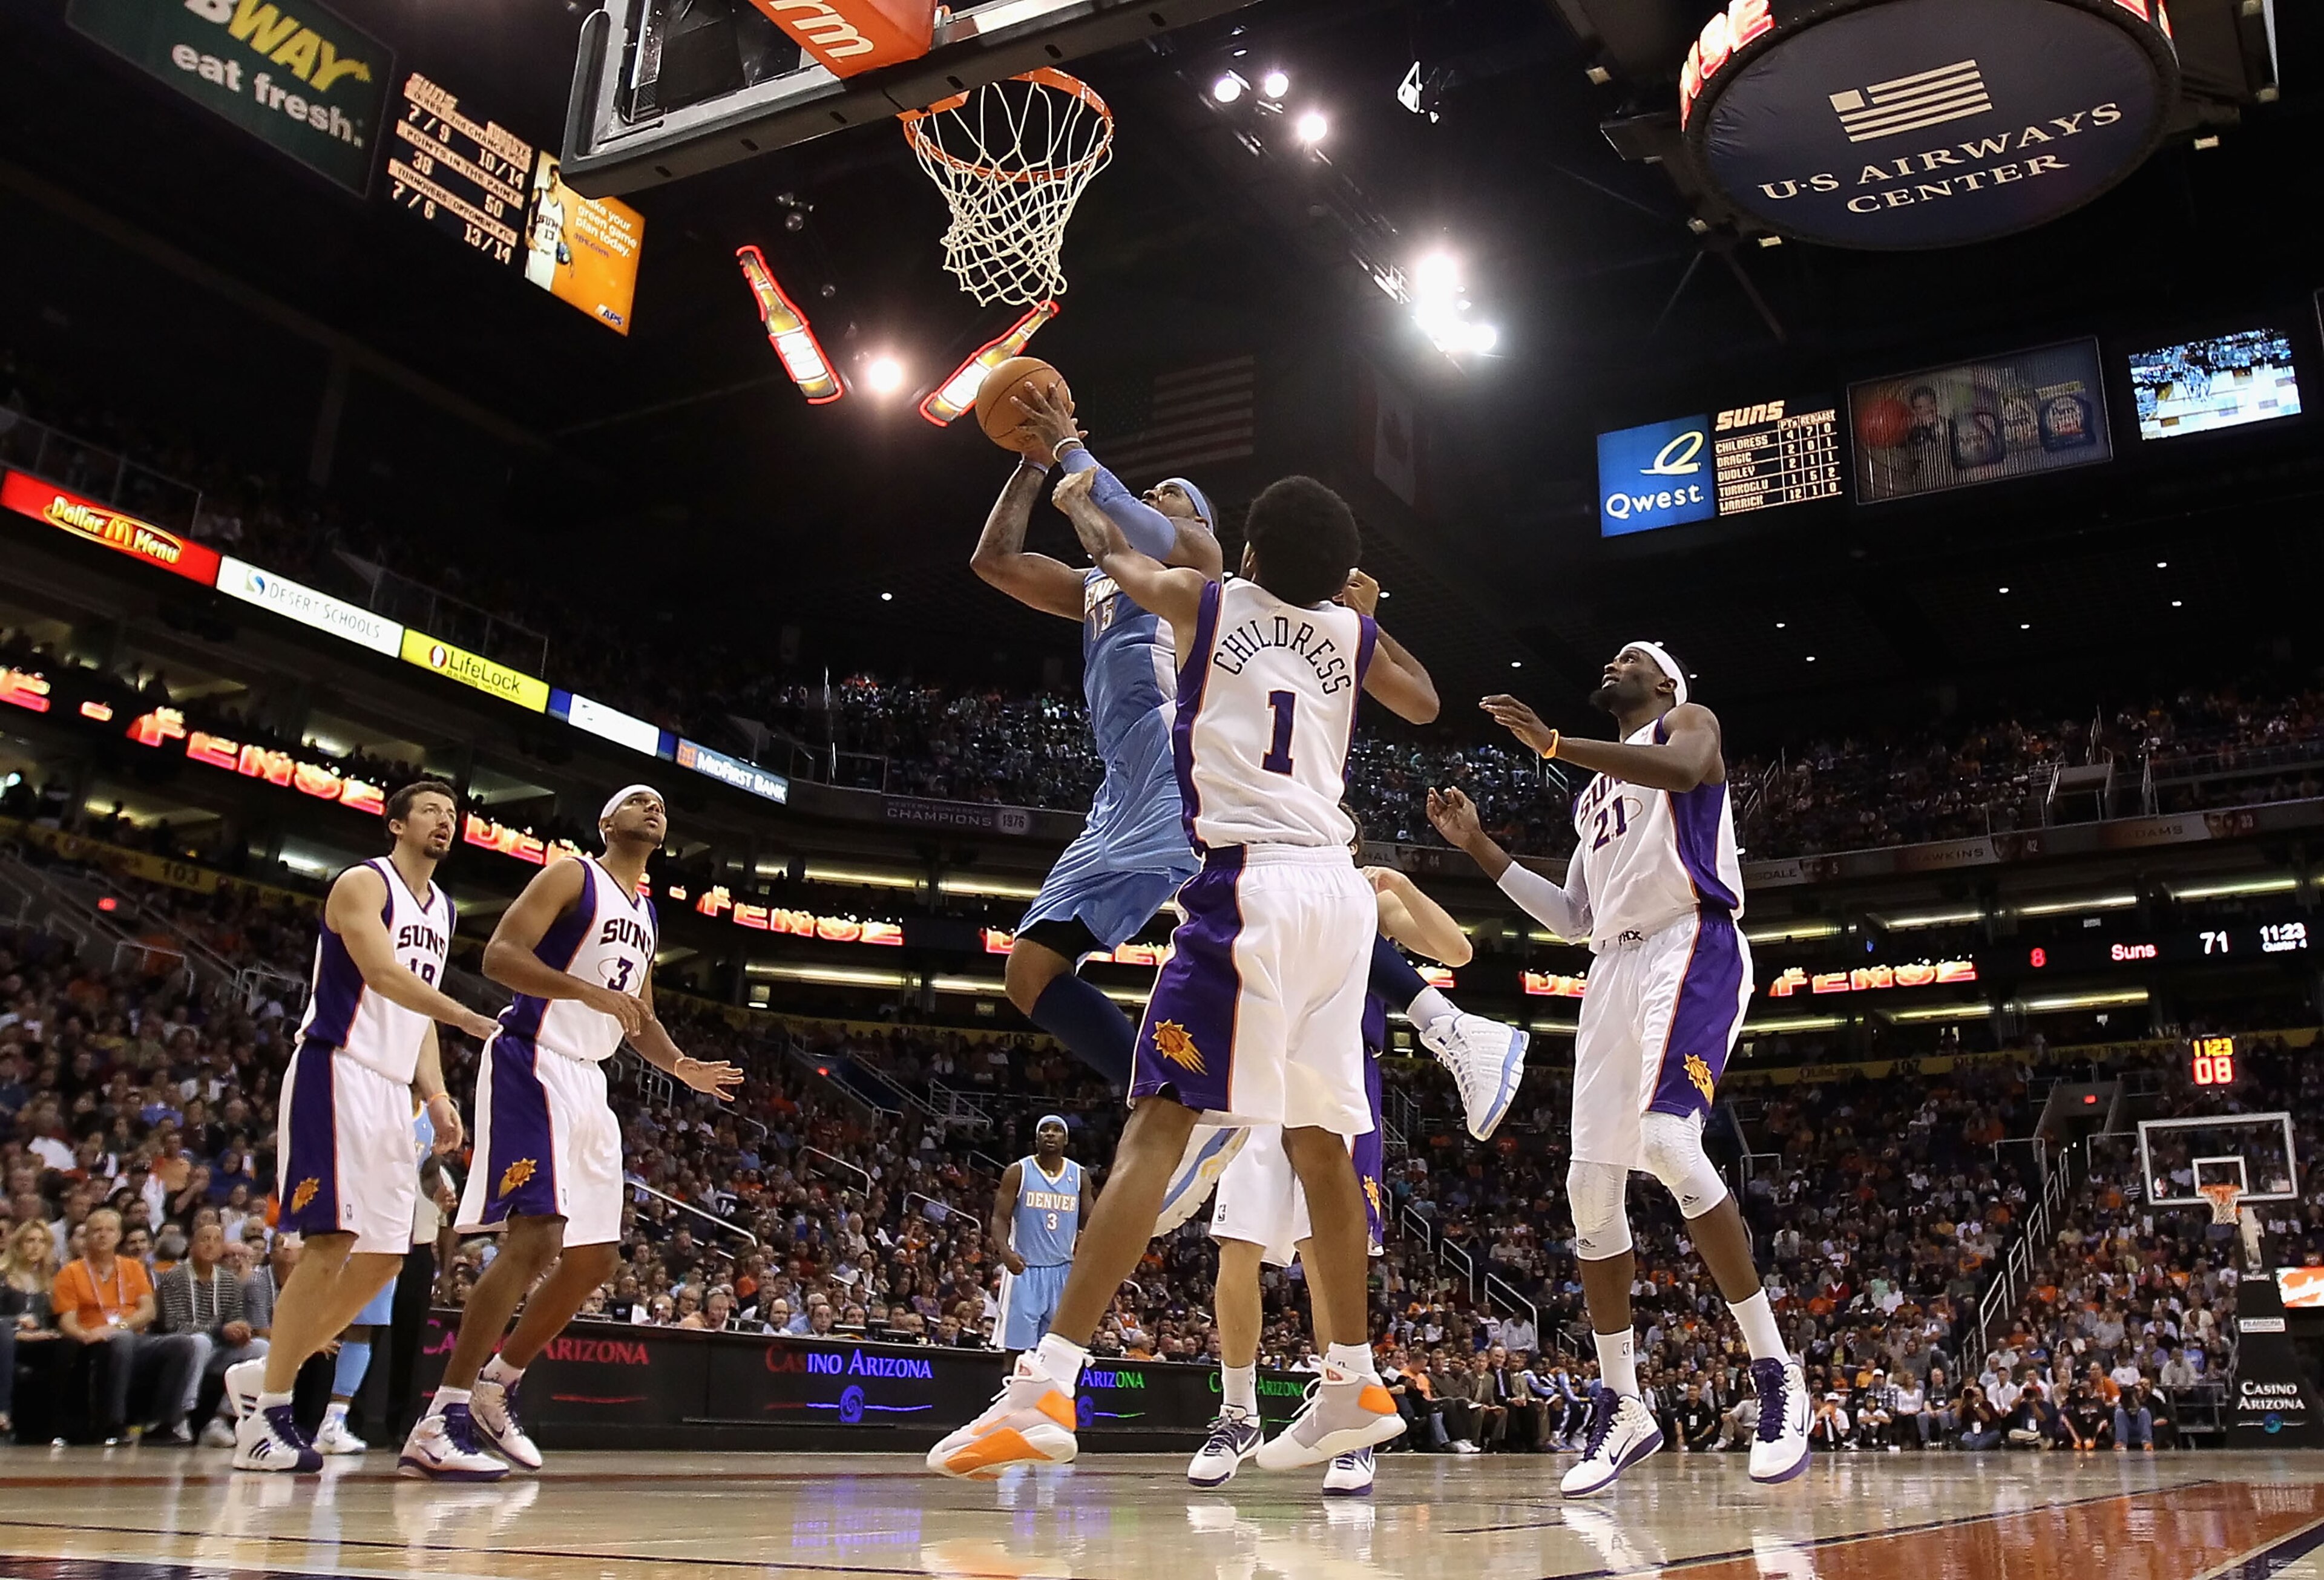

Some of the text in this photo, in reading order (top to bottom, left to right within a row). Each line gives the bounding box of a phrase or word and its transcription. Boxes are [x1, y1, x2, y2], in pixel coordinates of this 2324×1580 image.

[171, 43, 243, 93] eat
[1857, 102, 2122, 186] AIRWAYS
[407, 129, 516, 202] POINTS IN THE PAINT
[398, 167, 447, 203] TURNOVERS
[1846, 154, 2070, 214] CENTER
[485, 194, 505, 218] 50
[608, 211, 632, 231] your
[576, 217, 631, 258] plan today.
[577, 205, 637, 249] green game
[602, 309, 623, 326] APS
[1715, 400, 1785, 431] SUNS
[1715, 422, 1831, 454] CHILDRESS 4 7 0
[1716, 437, 1832, 468] DRAGIC 2 0 1
[1718, 451, 1833, 482] DUDLEY 2 1 1
[1791, 474, 1797, 484] 1
[1810, 471, 1817, 480] 5
[1828, 467, 1835, 477] 2
[1790, 489, 1802, 500] 12
[1812, 485, 1817, 495] 1
[1830, 482, 1836, 492] 0
[51, 496, 105, 534] Dollar
[133, 529, 180, 564] Menu
[269, 582, 380, 638] DESERT SCHOOLS
[1213, 616, 1351, 694] CHILDRESS
[449, 651, 521, 694] LifeLock
[1261, 689, 1296, 777] 1
[753, 775, 787, 801] BANK
[887, 807, 992, 827] CHAMPIONS
[1594, 795, 1627, 854] 21
[1908, 848, 1983, 862] AWKINS
[396, 925, 446, 962] SUNS
[2030, 922, 2306, 967] 8 Suns 71 11:23
[2299, 938, 2308, 949] 4
[607, 956, 634, 991] 3
[2194, 1057, 2232, 1085] 08
[1025, 1191, 1077, 1212] DENVER
[1046, 1213, 1058, 1231] 3
[765, 1343, 934, 1379] CASINO ARIZONA
[1080, 1368, 1146, 1389] ARIZONA
[2240, 1381, 2298, 1396] CASINO
[2237, 1395, 2306, 1411] ARIZONA
